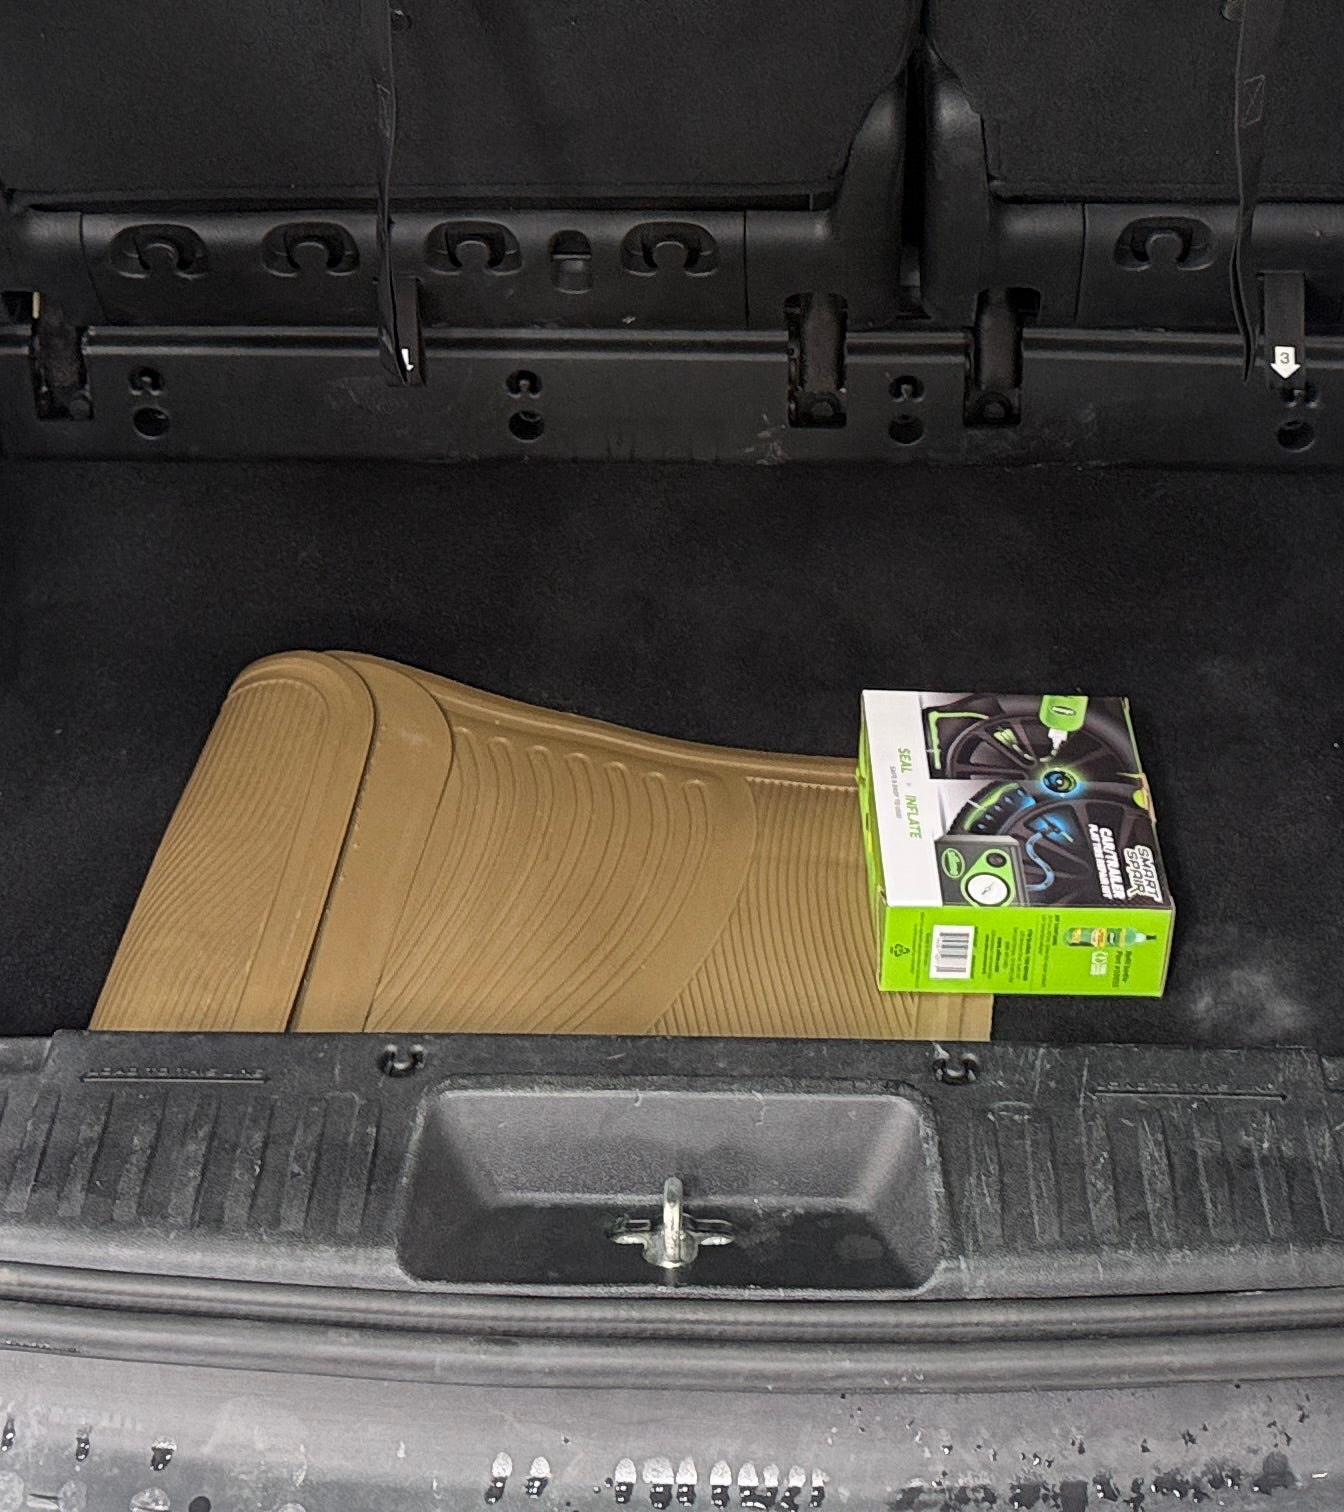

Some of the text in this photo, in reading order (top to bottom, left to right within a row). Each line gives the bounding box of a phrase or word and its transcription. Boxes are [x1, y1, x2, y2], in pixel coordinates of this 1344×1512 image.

[1280, 351, 1290, 365] 3
[897, 747, 922, 839] SEAL INFLATE
[1088, 824, 1101, 842] FLAT
[1101, 884, 1113, 900] KIT
[1099, 827, 1126, 900] CAR/TRAILER
[1126, 849, 1146, 895] SPAIR
[1137, 847, 1160, 900] SMART
